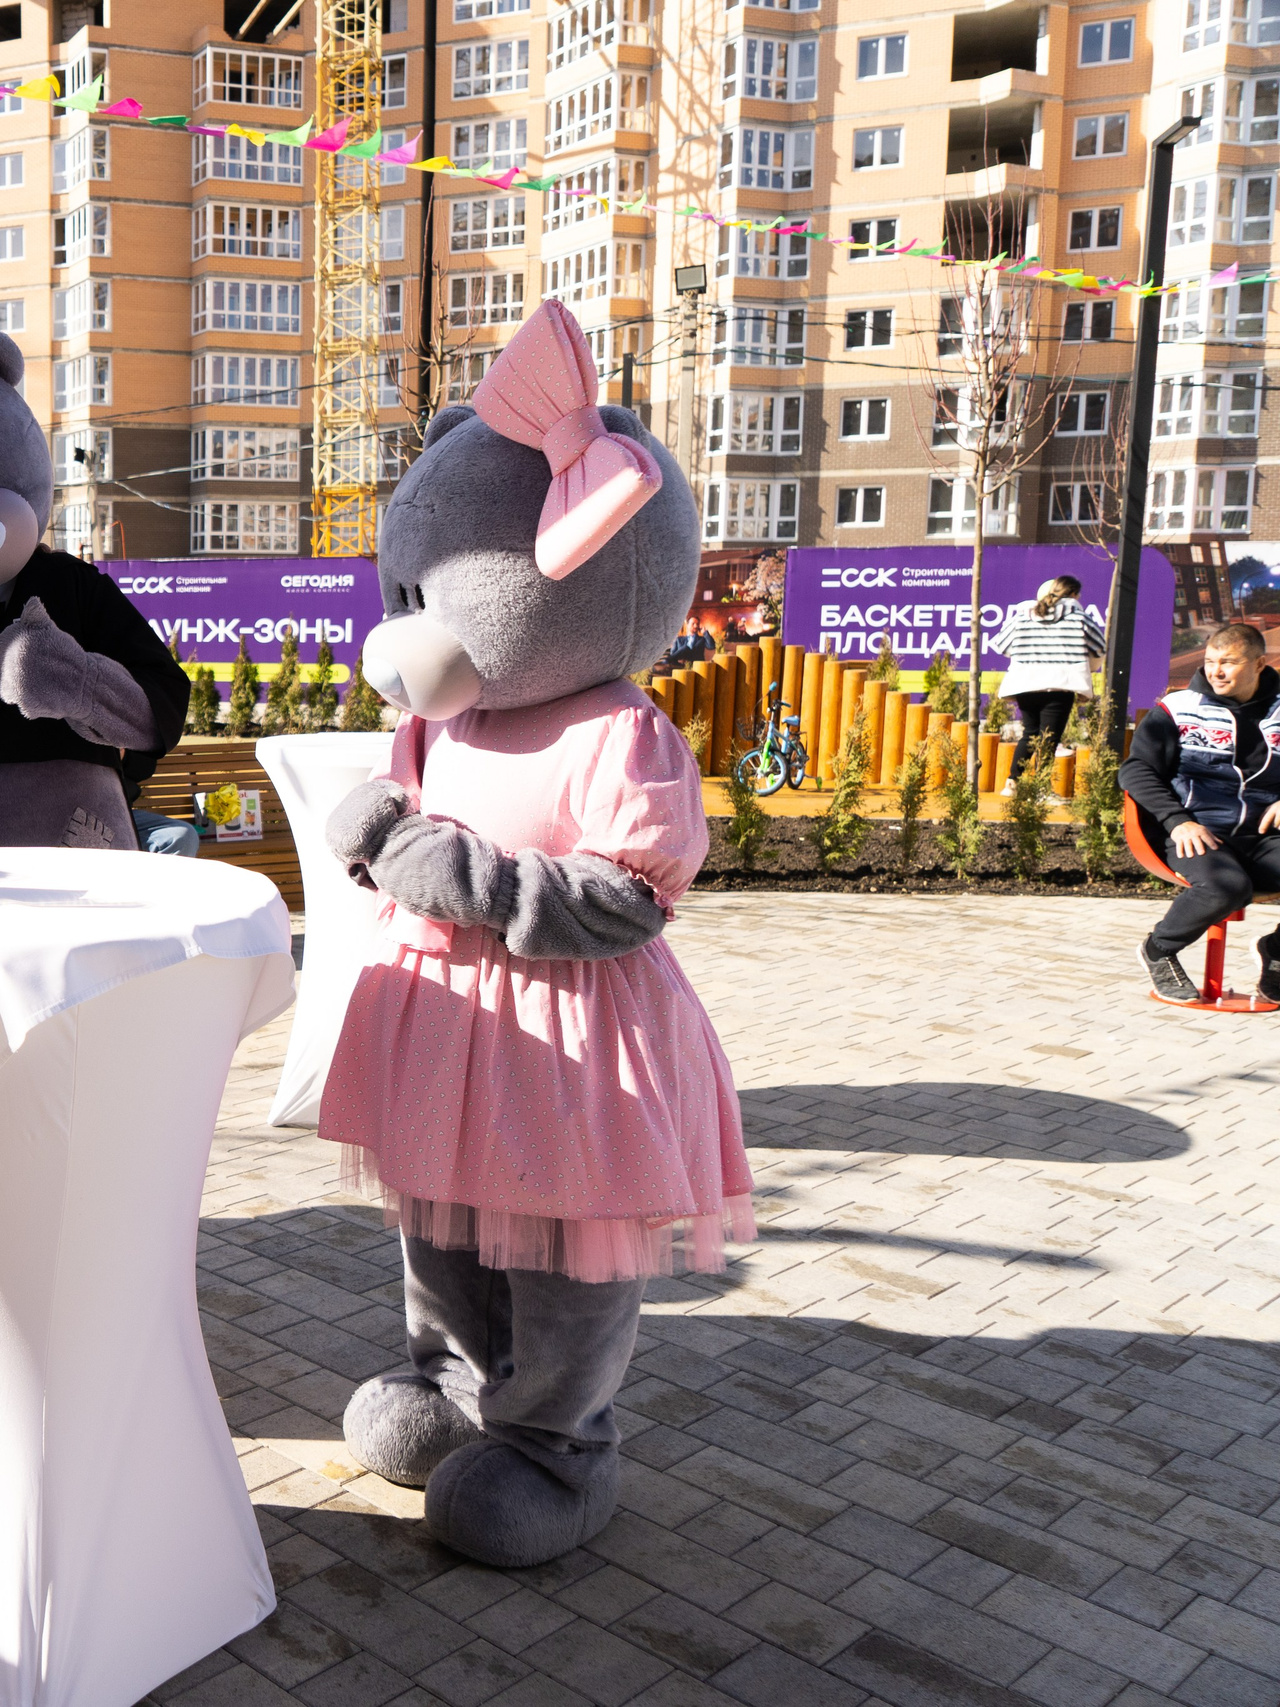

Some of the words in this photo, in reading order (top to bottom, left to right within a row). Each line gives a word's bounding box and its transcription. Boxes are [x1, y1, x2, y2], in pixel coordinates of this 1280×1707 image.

[902, 567, 973, 578] Строительная
[175, 576, 229, 585] Строительная
[280, 575, 354, 588] СЕГОДНЯ
[902, 578, 950, 587] компания
[819, 631, 1004, 659] ПЛОЩАДК
